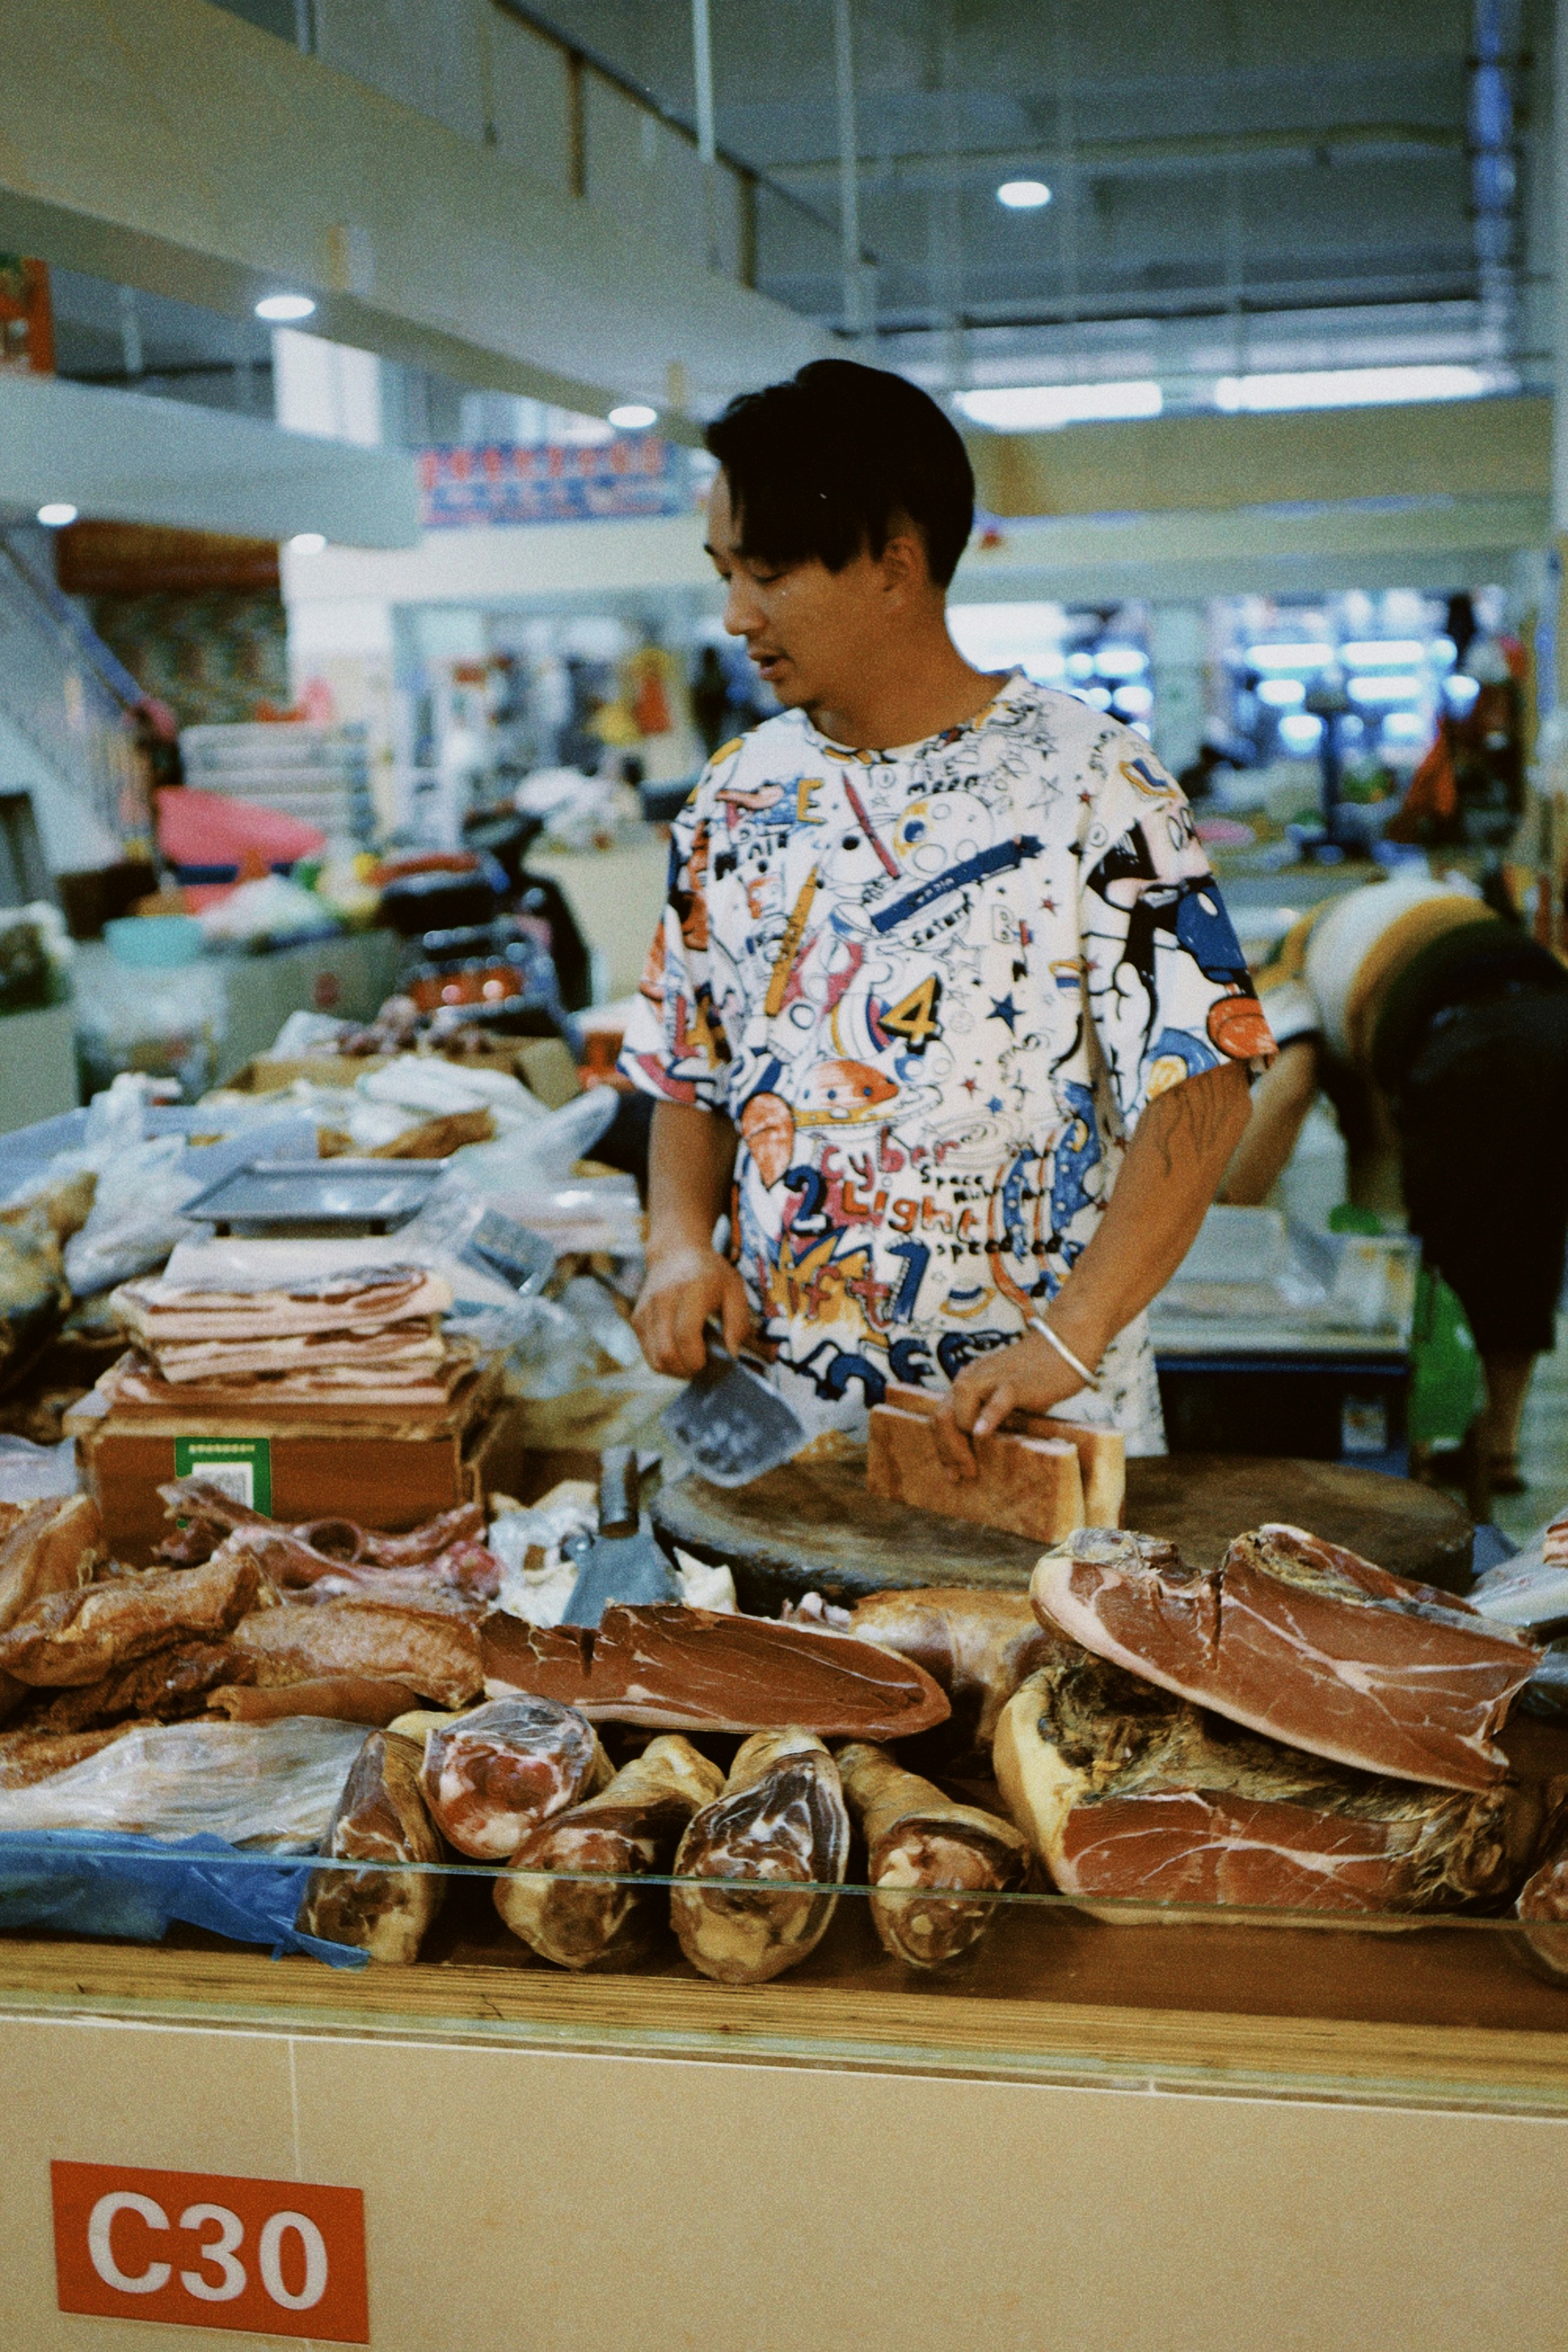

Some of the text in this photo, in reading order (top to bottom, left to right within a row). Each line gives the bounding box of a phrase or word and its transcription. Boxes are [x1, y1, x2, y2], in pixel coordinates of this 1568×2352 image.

[880, 972, 943, 1043] 4
[784, 1163, 833, 1237] 2
[88, 2191, 328, 2311] C30
